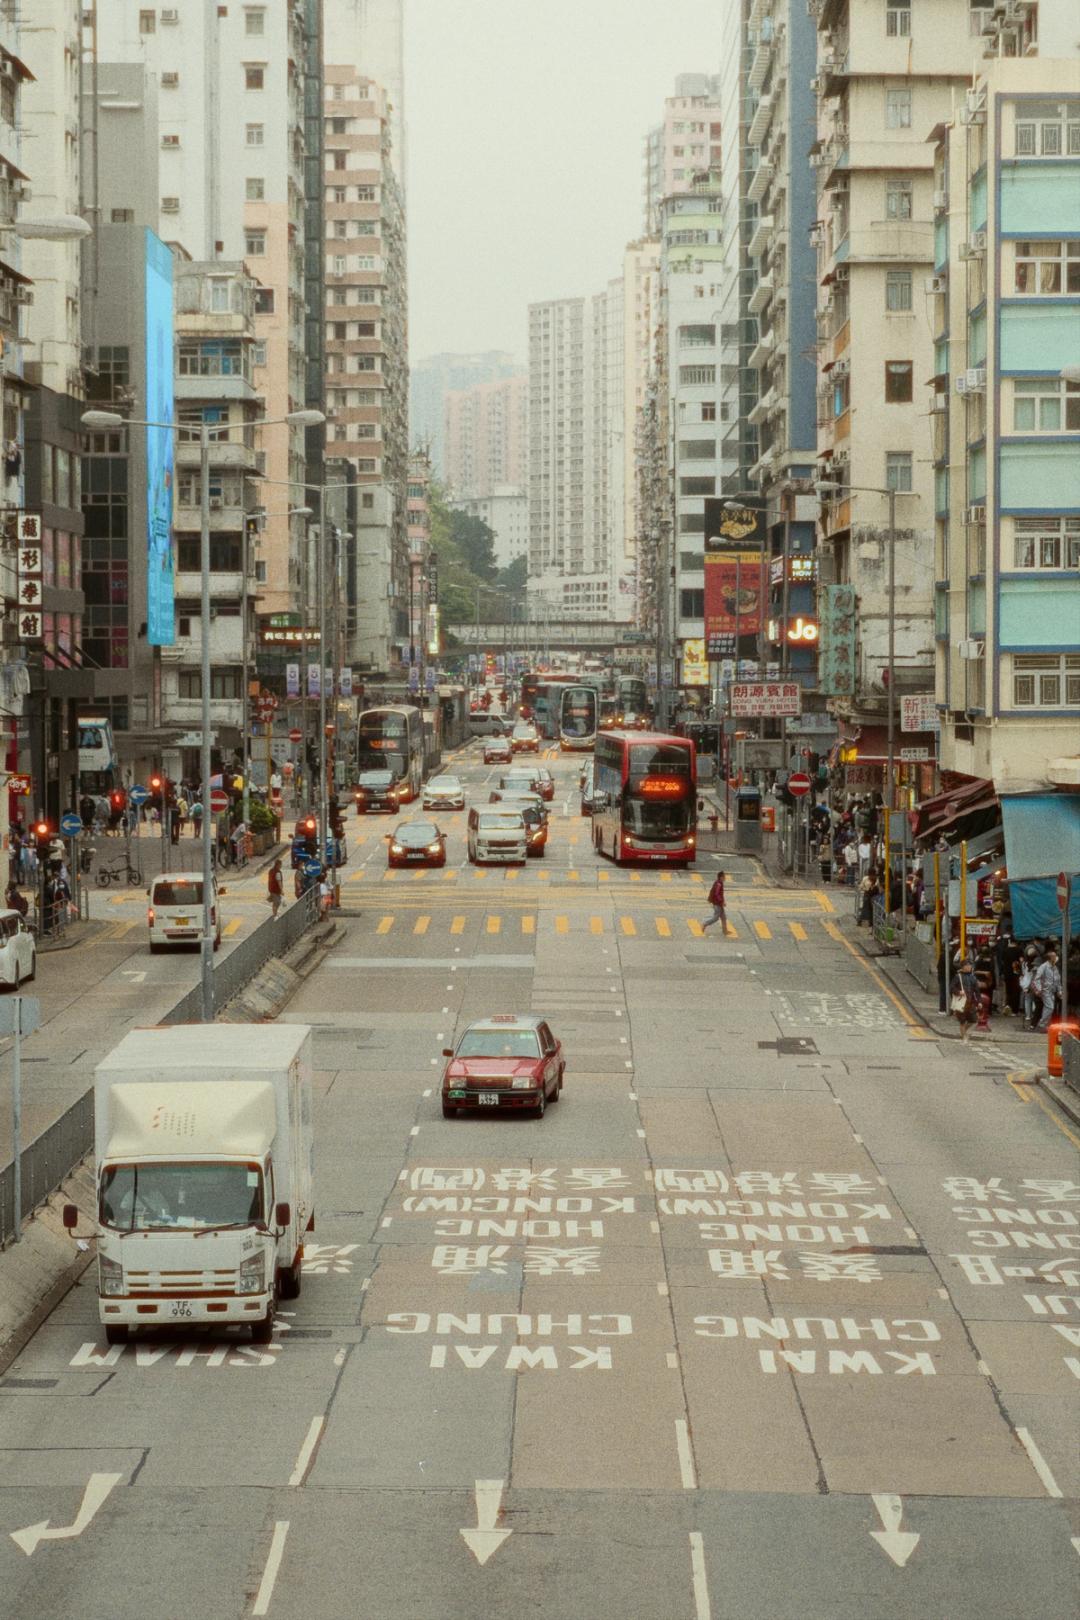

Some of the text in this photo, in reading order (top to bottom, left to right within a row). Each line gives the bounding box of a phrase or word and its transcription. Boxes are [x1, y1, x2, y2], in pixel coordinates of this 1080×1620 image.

[21, 517, 39, 636] 龍形拳館
[733, 685, 798, 698] 朗源賓館
[904, 697, 920, 731] 新華
[402, 1196, 636, 1214] KONG(W)
[659, 1198, 893, 1221] KONG(W)
[434, 1218, 604, 1238] HONG
[699, 1222, 870, 1245] HONG
[430, 1244, 602, 1276] 葵涌
[707, 1248, 884, 1283] 葵涌
[171, 1308, 193, 1317] 996
[385, 1312, 633, 1336] CHUNG
[692, 1315, 942, 1342] CHUNG
[429, 1344, 613, 1370] KWAI
[757, 1348, 937, 1376] KWAI
